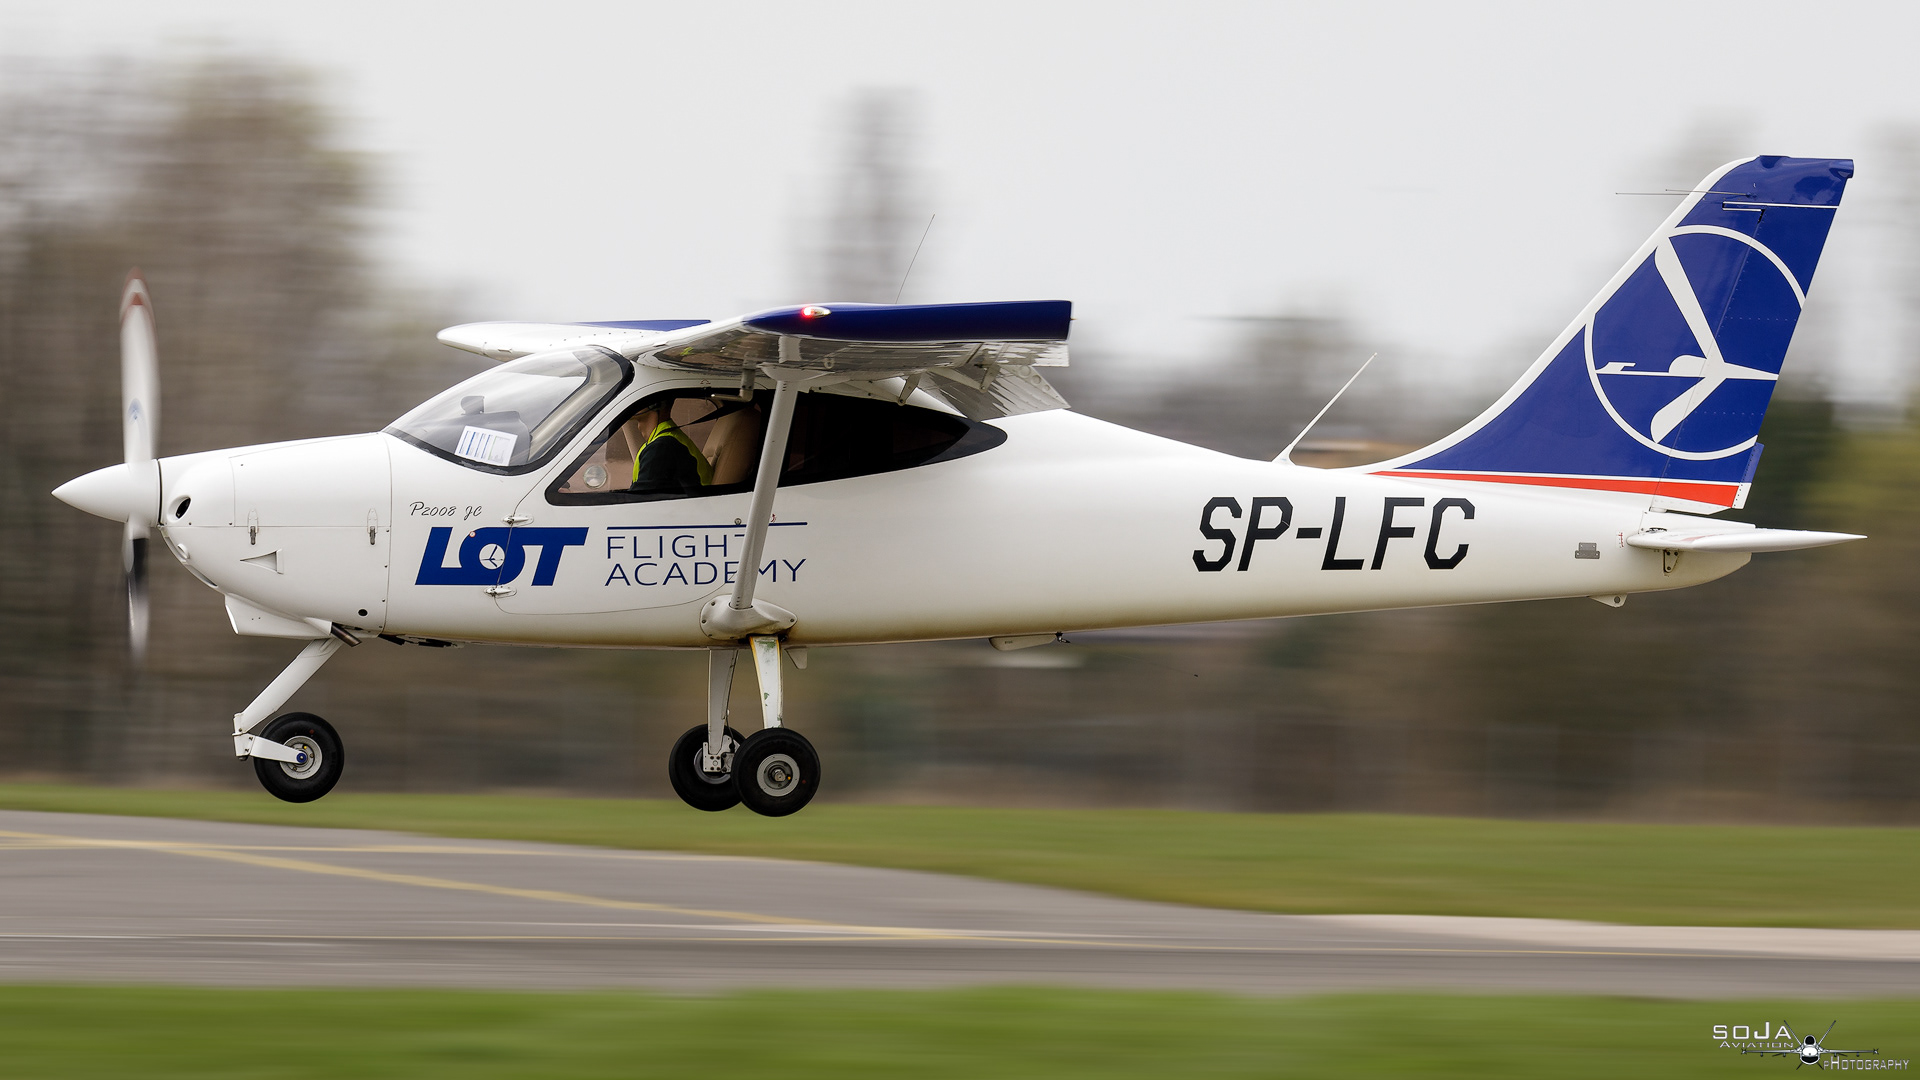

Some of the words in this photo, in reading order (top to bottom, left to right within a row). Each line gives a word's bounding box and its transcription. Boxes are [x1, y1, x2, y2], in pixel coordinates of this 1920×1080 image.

[409, 501, 456, 516] P2008
[606, 534, 746, 559] FLIGH
[1192, 496, 1475, 572] SP-LFC
[415, 527, 590, 586] LOT
